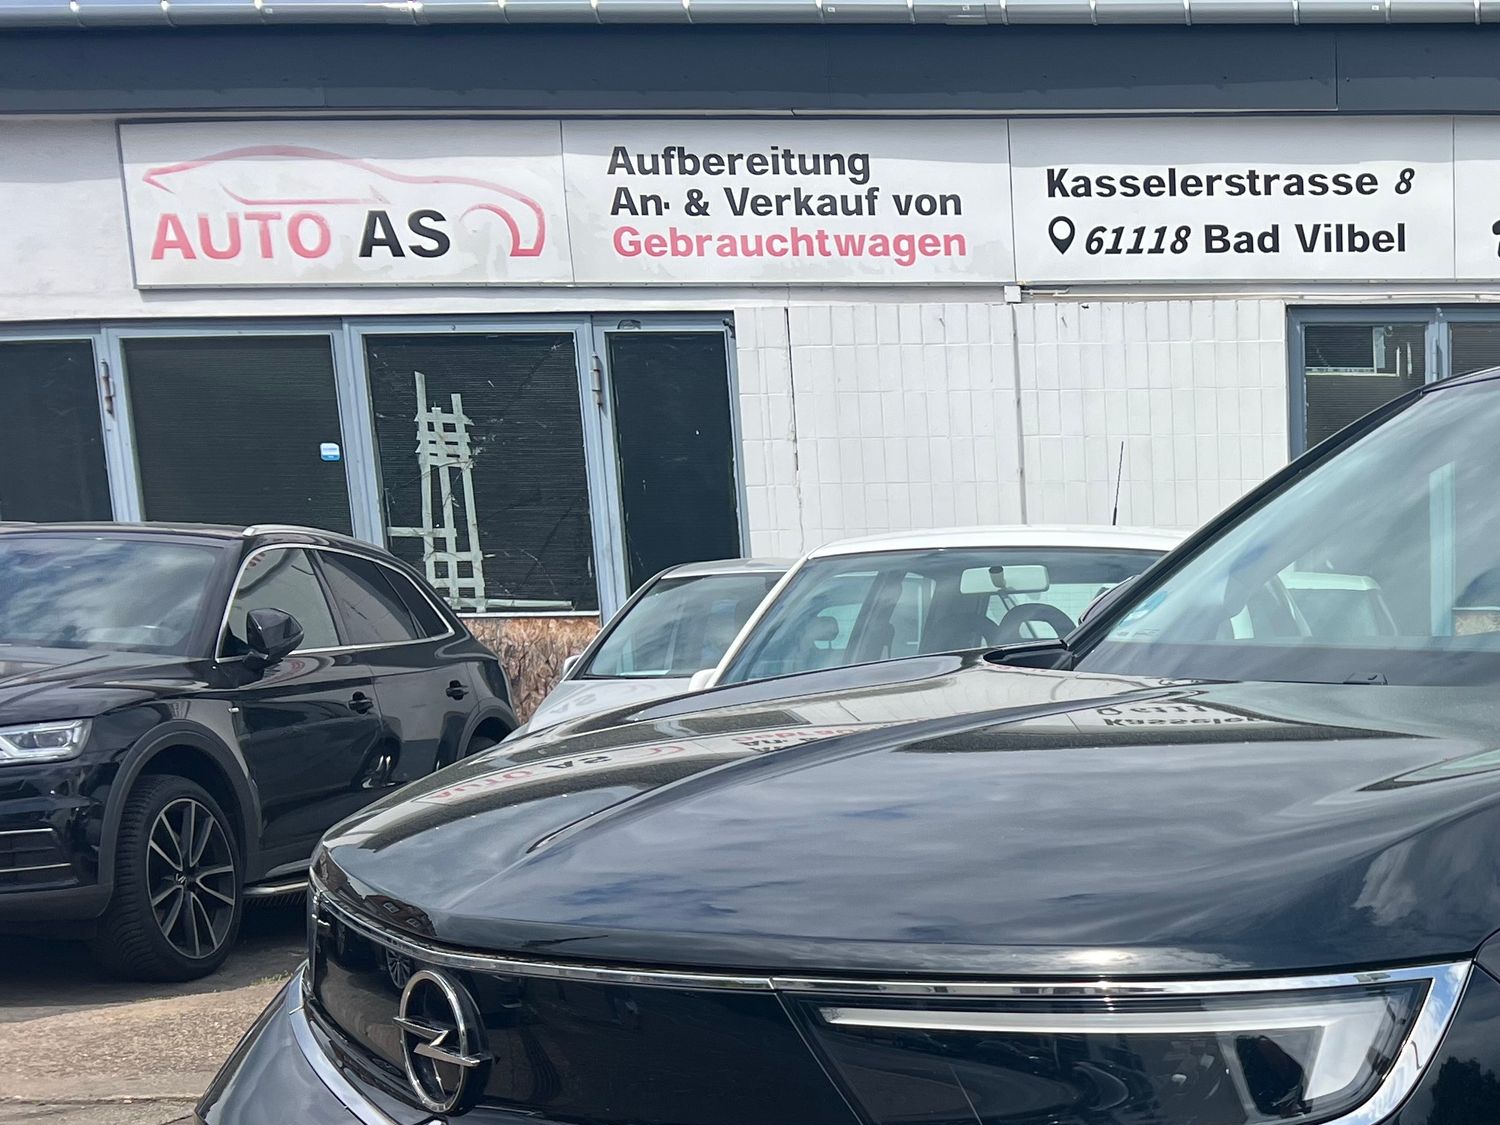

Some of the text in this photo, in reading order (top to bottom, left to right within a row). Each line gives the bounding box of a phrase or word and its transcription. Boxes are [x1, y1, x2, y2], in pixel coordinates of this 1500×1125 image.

[607, 145, 870, 185] Aufbereitung
[1046, 167, 1415, 198] Kasselerstrasse 8
[684, 188, 711, 217] &
[723, 186, 880, 217] Verkauf
[891, 194, 962, 216] von
[151, 209, 451, 260] AUTO AS
[613, 225, 967, 267] Gebrauchtwagen
[1085, 222, 1406, 255] 61118 Bad Vilbel
